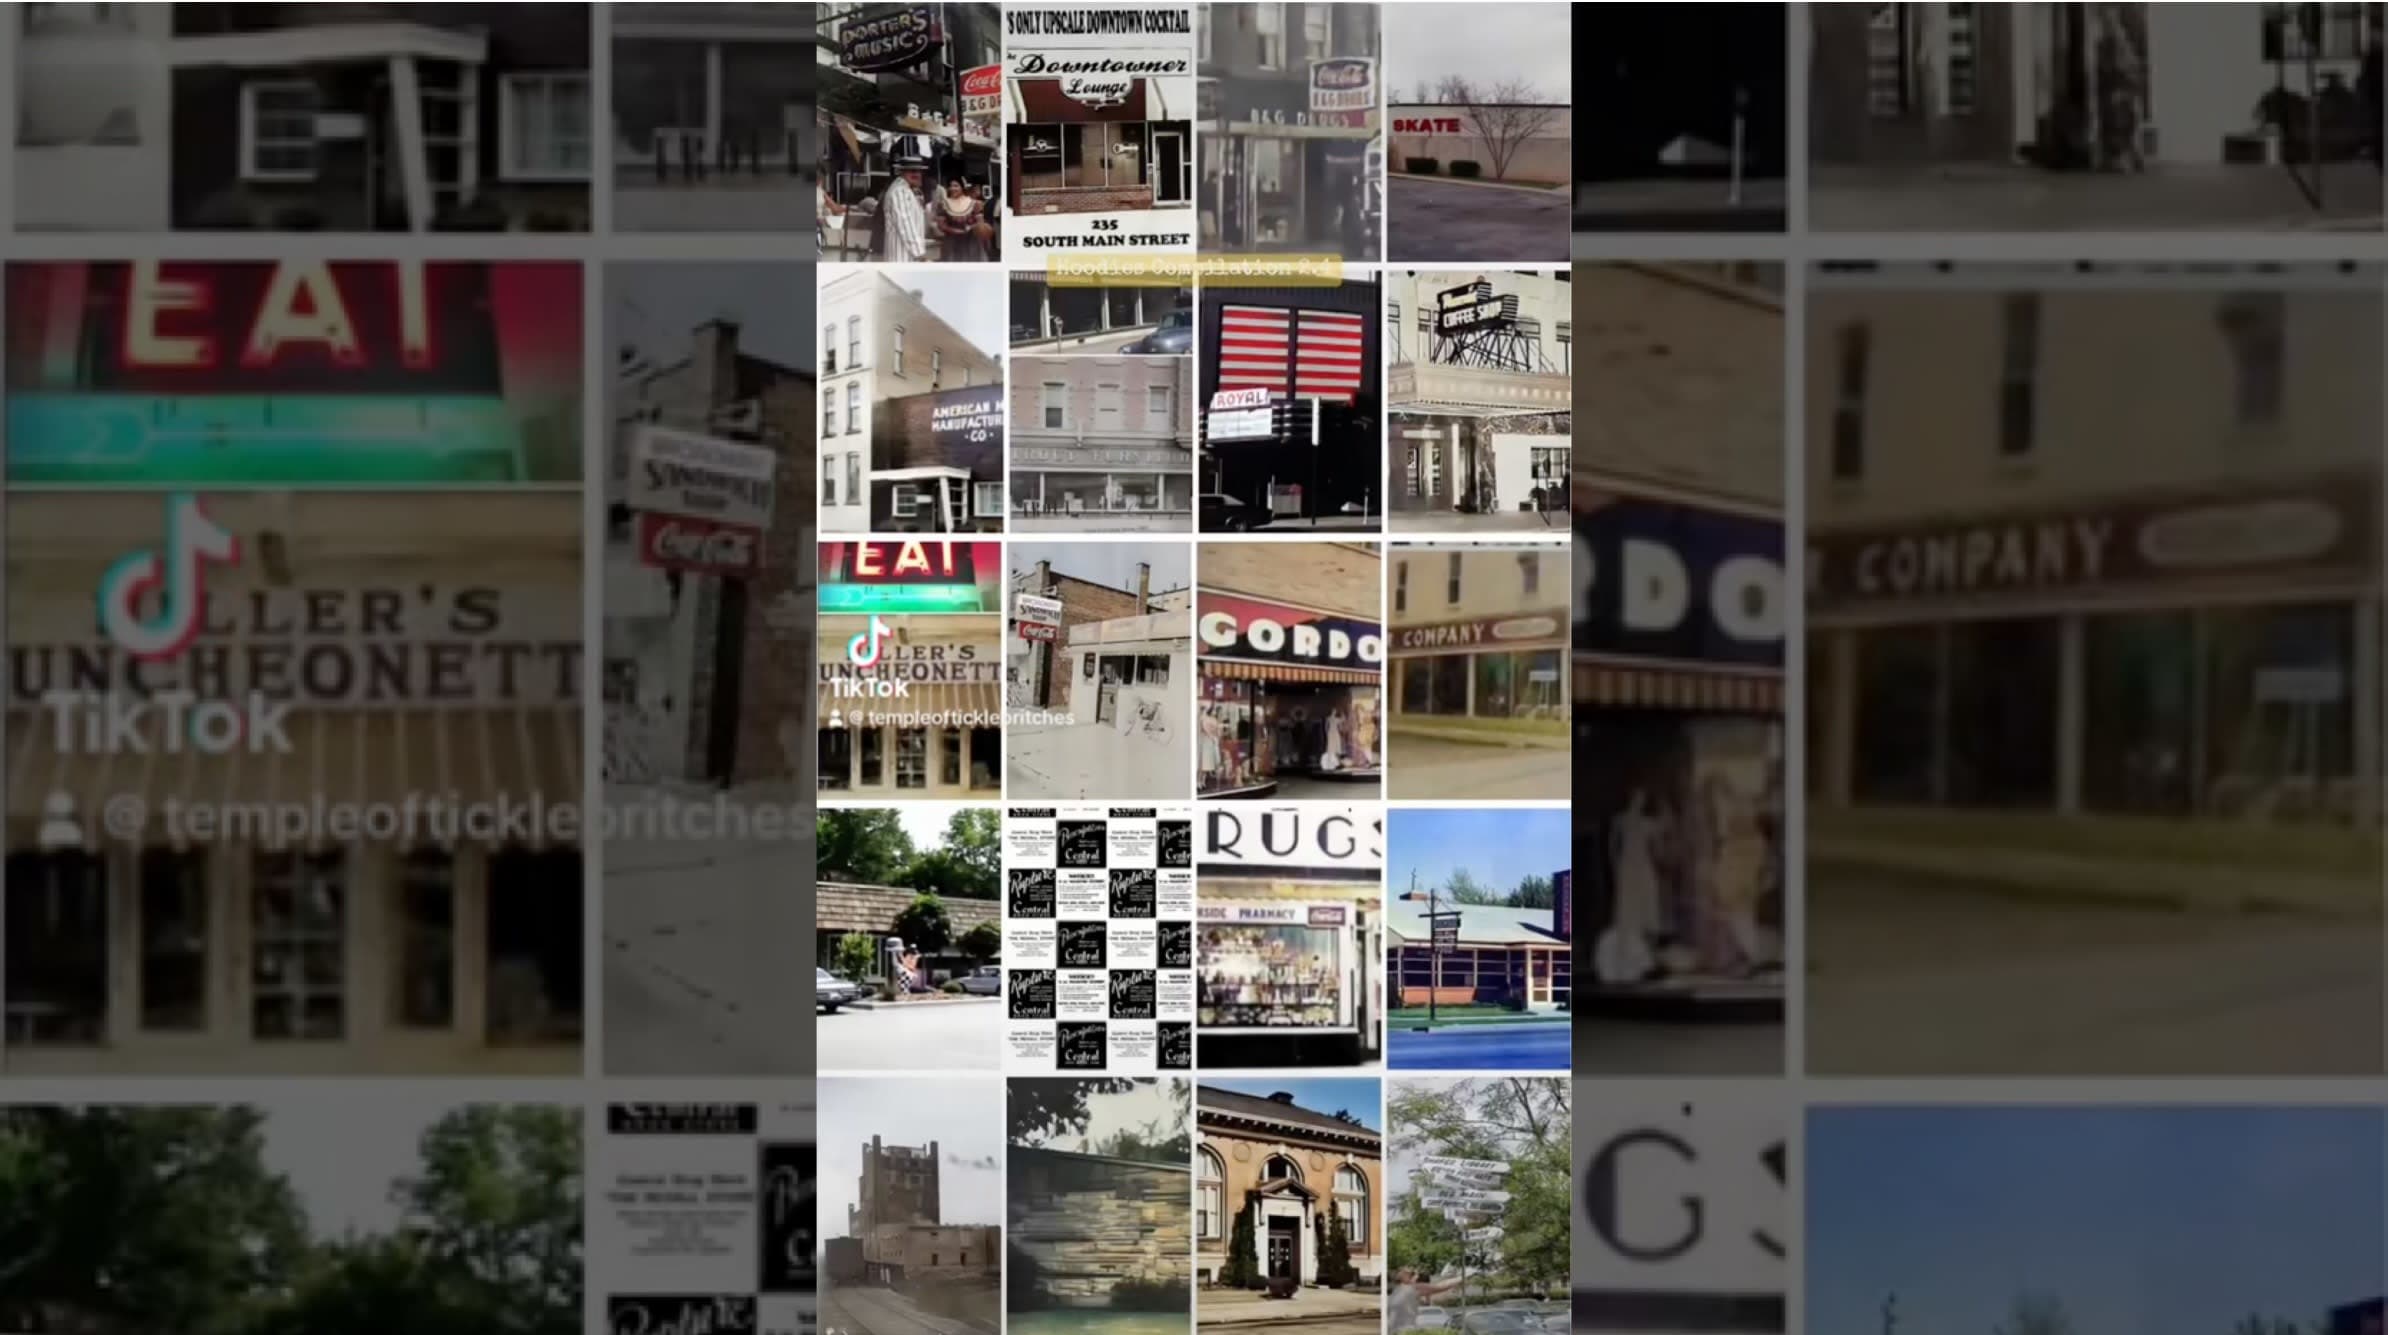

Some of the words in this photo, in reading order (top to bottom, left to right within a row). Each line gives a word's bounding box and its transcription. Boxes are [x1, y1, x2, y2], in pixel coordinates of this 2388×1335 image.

[842, 8, 928, 46] PORTER'S
[1016, 11, 1041, 34] ONLY
[1043, 11, 1085, 34] UPSCALE
[1087, 11, 1143, 34] DOWNTOWN
[1144, 10, 1190, 33] COCKTAIL
[854, 31, 914, 58] MUSIC
[1014, 53, 1188, 74] Downtowner
[1066, 78, 1128, 97] Lounge
[1393, 118, 1460, 134] SKATE
[1092, 219, 1118, 231] 235
[1023, 236, 1078, 248] SOUTH
[1082, 235, 1125, 247] MAIN
[1129, 233, 1190, 245] STREET
[1217, 391, 1264, 407] ROYAL
[932, 402, 991, 419] AMERICAN
[1856, 517, 2113, 591] COMPANY
[1199, 611, 1382, 663] GORDO
[1403, 623, 1485, 647] COMPANY
[1065, 848, 1099, 860] Central
[1013, 901, 1050, 914] Central
[1114, 901, 1150, 914] Central
[1239, 908, 1296, 920] PHARMACY
[1065, 948, 1099, 960] Central
[1013, 1001, 1050, 1014] Central
[1114, 1001, 1150, 1014] Central
[1065, 1049, 1099, 1061] Central
